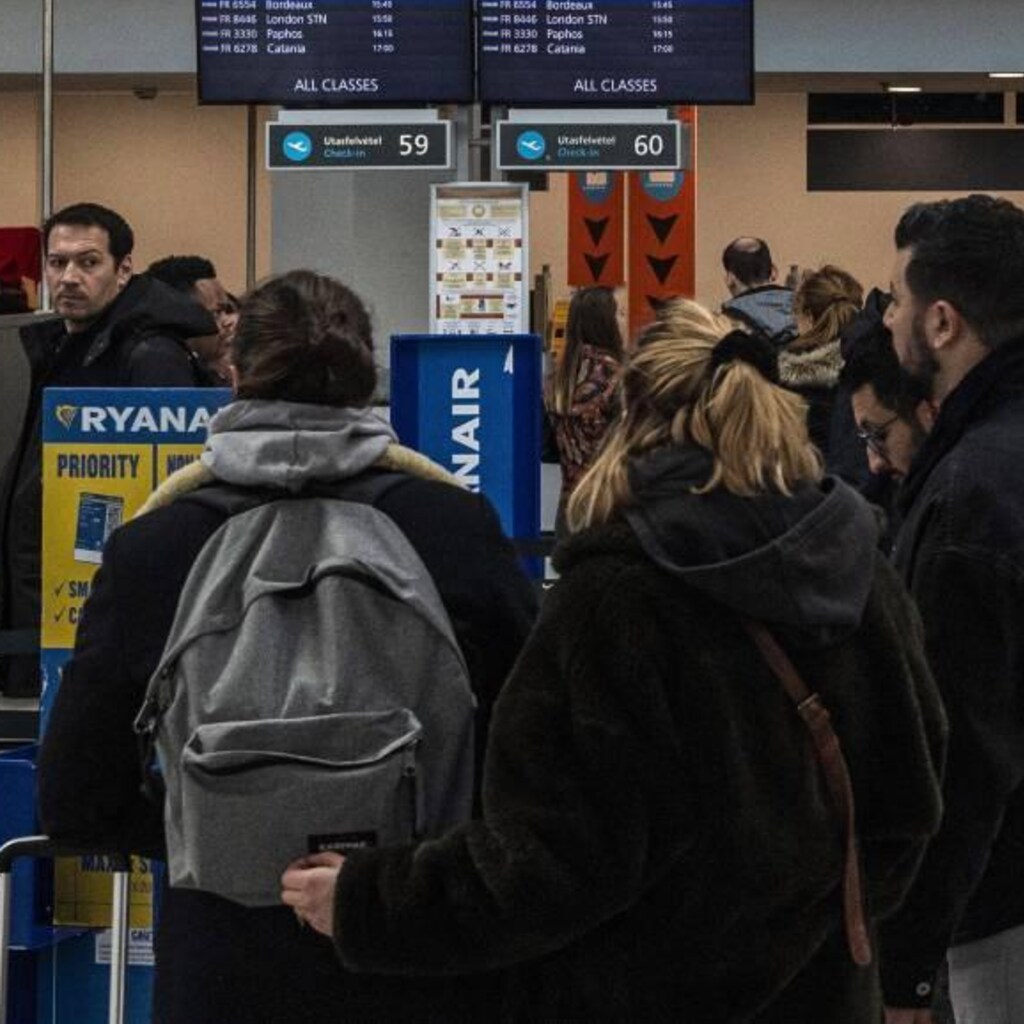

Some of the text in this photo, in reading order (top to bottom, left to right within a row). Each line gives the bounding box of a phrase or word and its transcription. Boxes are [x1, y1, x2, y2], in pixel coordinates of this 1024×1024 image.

[545, 0, 594, 11] Bordeaux
[266, 13, 328, 25] London STN
[546, 13, 608, 25] London STN
[266, 28, 303, 41] Paphos
[546, 28, 584, 41] Paphos
[266, 42, 306, 54] Catania
[546, 42, 586, 55] Catania
[293, 78, 379, 92] ALL CLASSES
[573, 78, 658, 93] ALL CLASSES
[399, 134, 429, 156] 59
[634, 134, 664, 156] 60
[81, 405, 221, 432] RYANA
[451, 367, 480, 494] NAIR
[57, 454, 140, 478] PRIORITY
